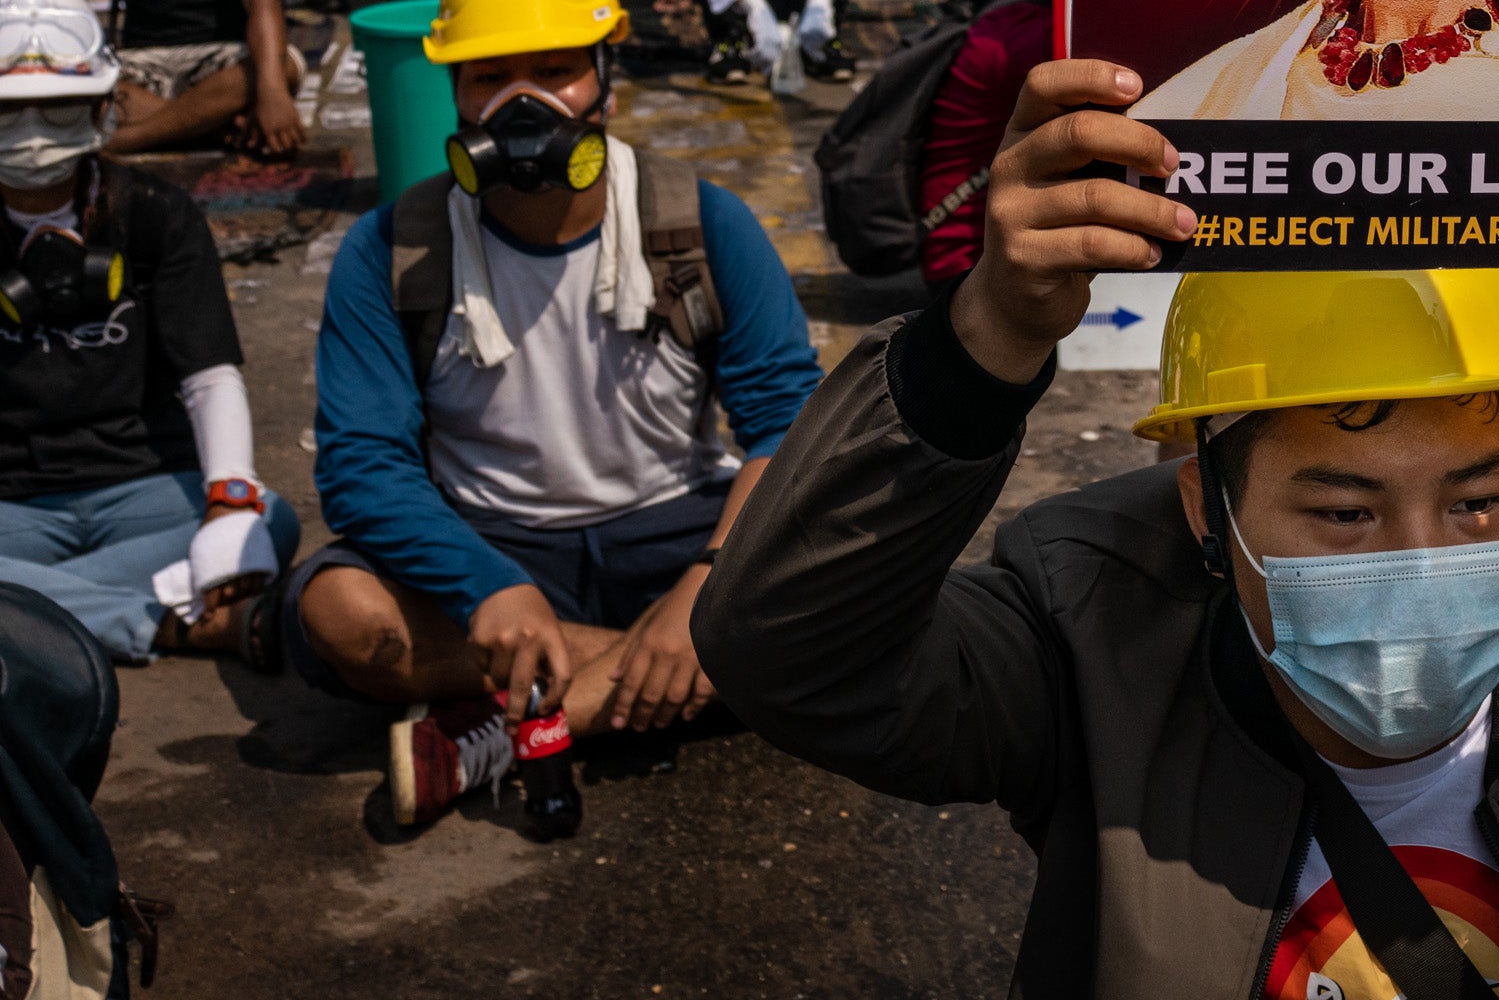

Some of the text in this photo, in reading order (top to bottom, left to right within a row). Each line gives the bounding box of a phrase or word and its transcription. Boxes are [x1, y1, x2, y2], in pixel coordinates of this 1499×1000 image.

[1126, 152, 1290, 194] REE
[1311, 151, 1449, 195] OUR
[1192, 214, 1355, 248] #REJECT
